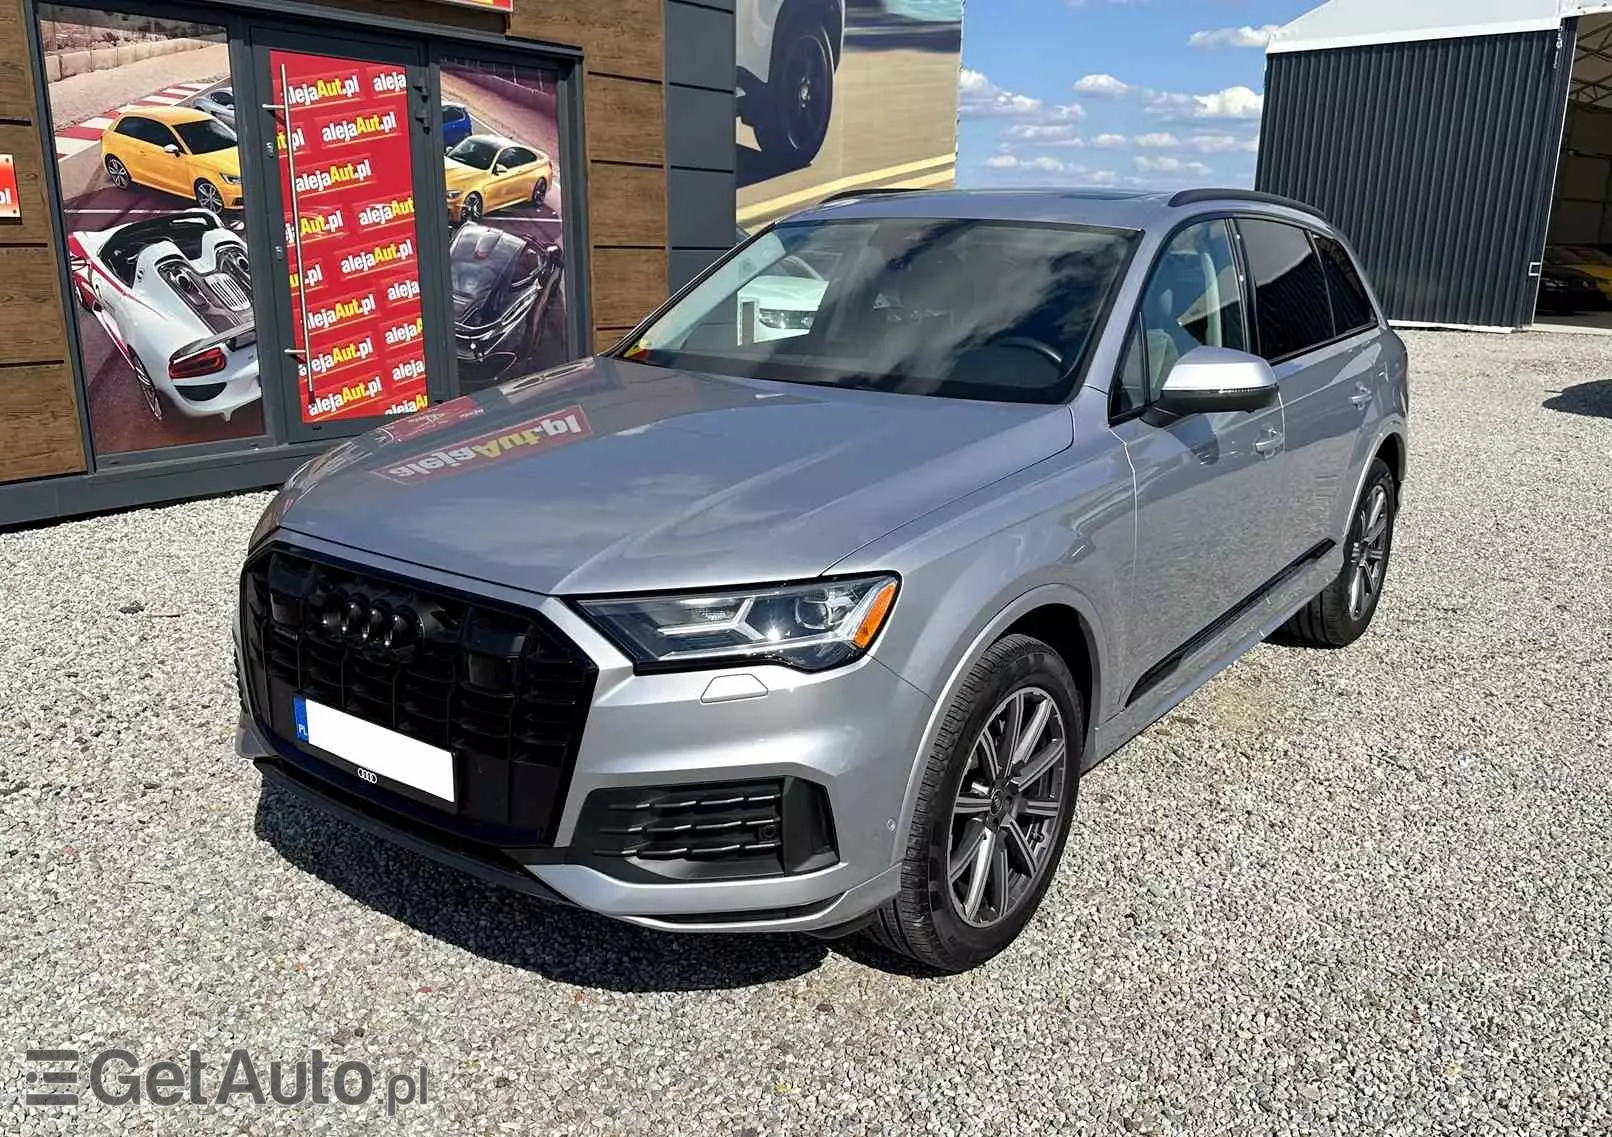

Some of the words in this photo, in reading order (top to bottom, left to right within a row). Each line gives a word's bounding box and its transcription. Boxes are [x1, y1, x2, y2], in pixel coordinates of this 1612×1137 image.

[322, 111, 397, 142] alejaAut.pl
[295, 158, 372, 192] alejaAut.pl
[341, 239, 413, 274] alejaAut.pl
[298, 337, 373, 377] aejaAut.pl
[308, 376, 382, 416] alejaAut.pl
[298, 723, 308, 735] PL
